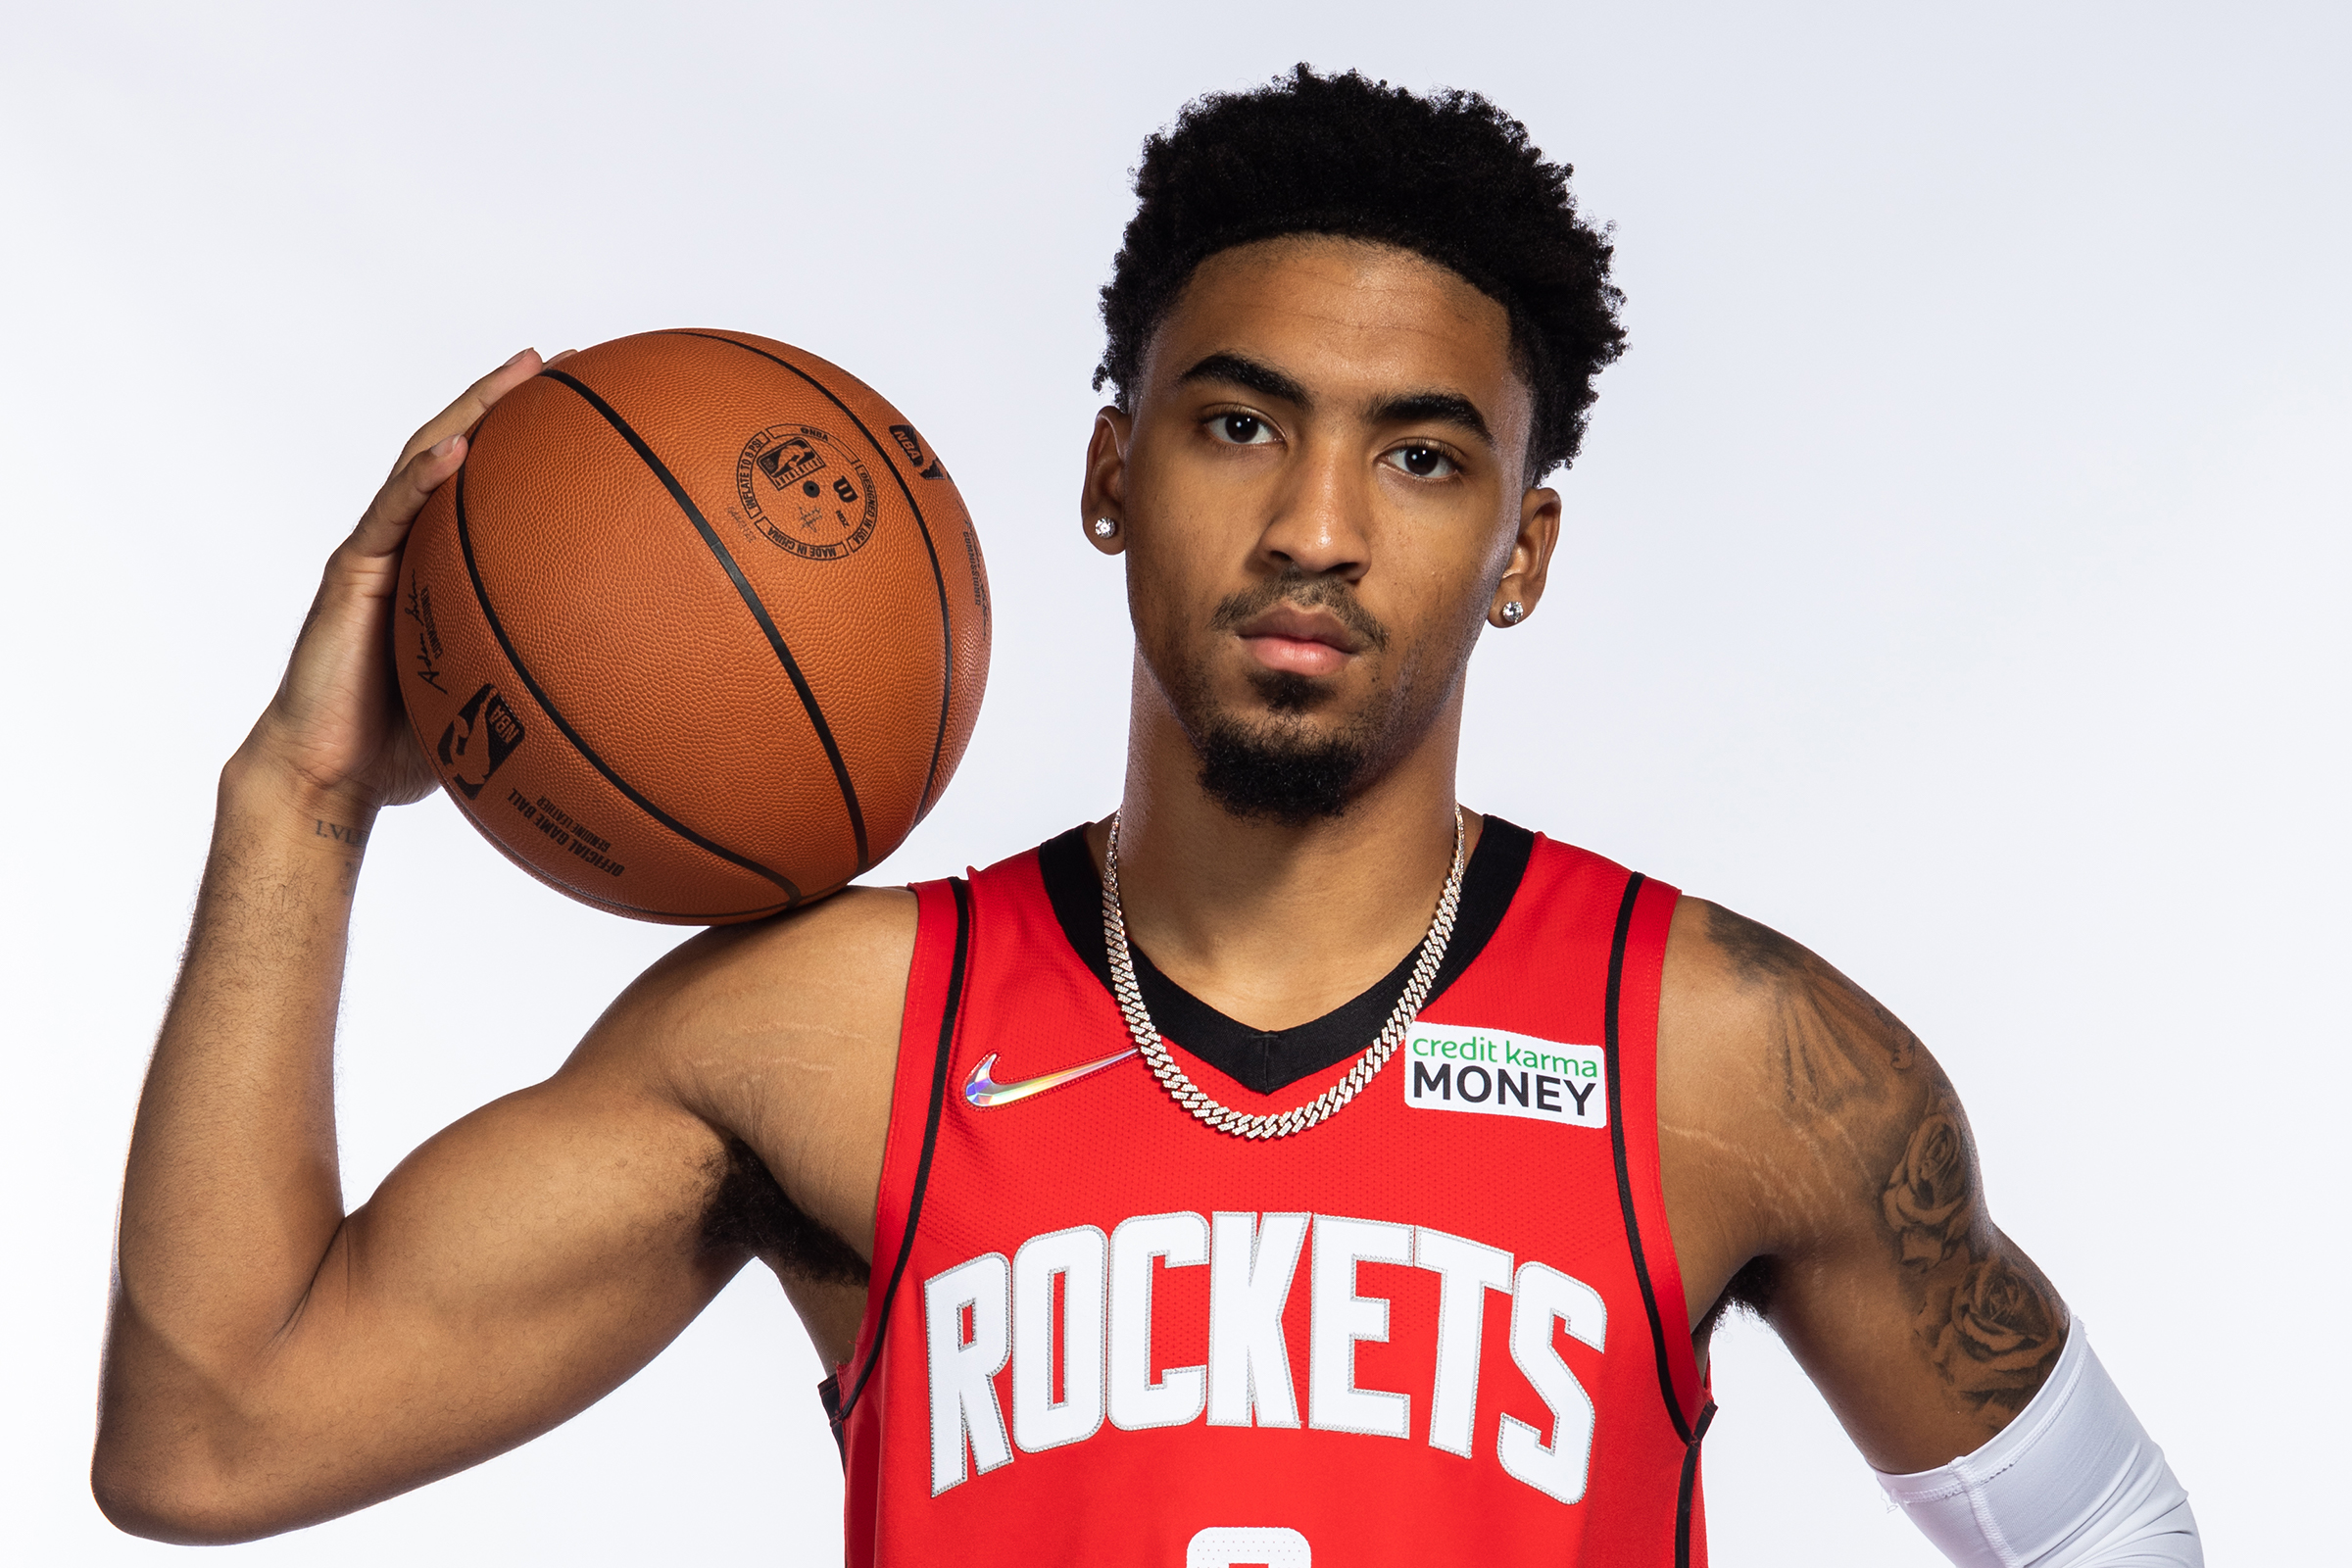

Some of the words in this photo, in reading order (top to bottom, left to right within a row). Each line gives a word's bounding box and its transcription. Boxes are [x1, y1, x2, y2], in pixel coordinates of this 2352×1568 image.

[748, 438, 763, 452] PSI
[893, 430, 921, 460] NBA
[741, 460, 751, 470] TO
[740, 472, 757, 510] INFLATE
[859, 472, 876, 517] DESIGNED
[767, 526, 796, 551] CHINA
[852, 528, 869, 545] USA
[863, 518, 873, 529] IN
[797, 545, 808, 555] IN
[809, 547, 837, 557] MADE
[962, 531, 981, 606] COMMISSIONER
[419, 586, 443, 660] COMMISSIONER
[489, 705, 519, 744] NBA
[507, 787, 537, 820] BALL
[536, 795, 575, 829] LEATHER
[533, 816, 570, 846] GAME
[571, 823, 611, 854] GENUINE
[567, 838, 625, 877] OFFICIAL
[1413, 1037, 1497, 1062] credit
[1506, 1041, 1597, 1077] karma
[1414, 1060, 1596, 1116] MONEY
[923, 1211, 1607, 1505] ROCKETS
